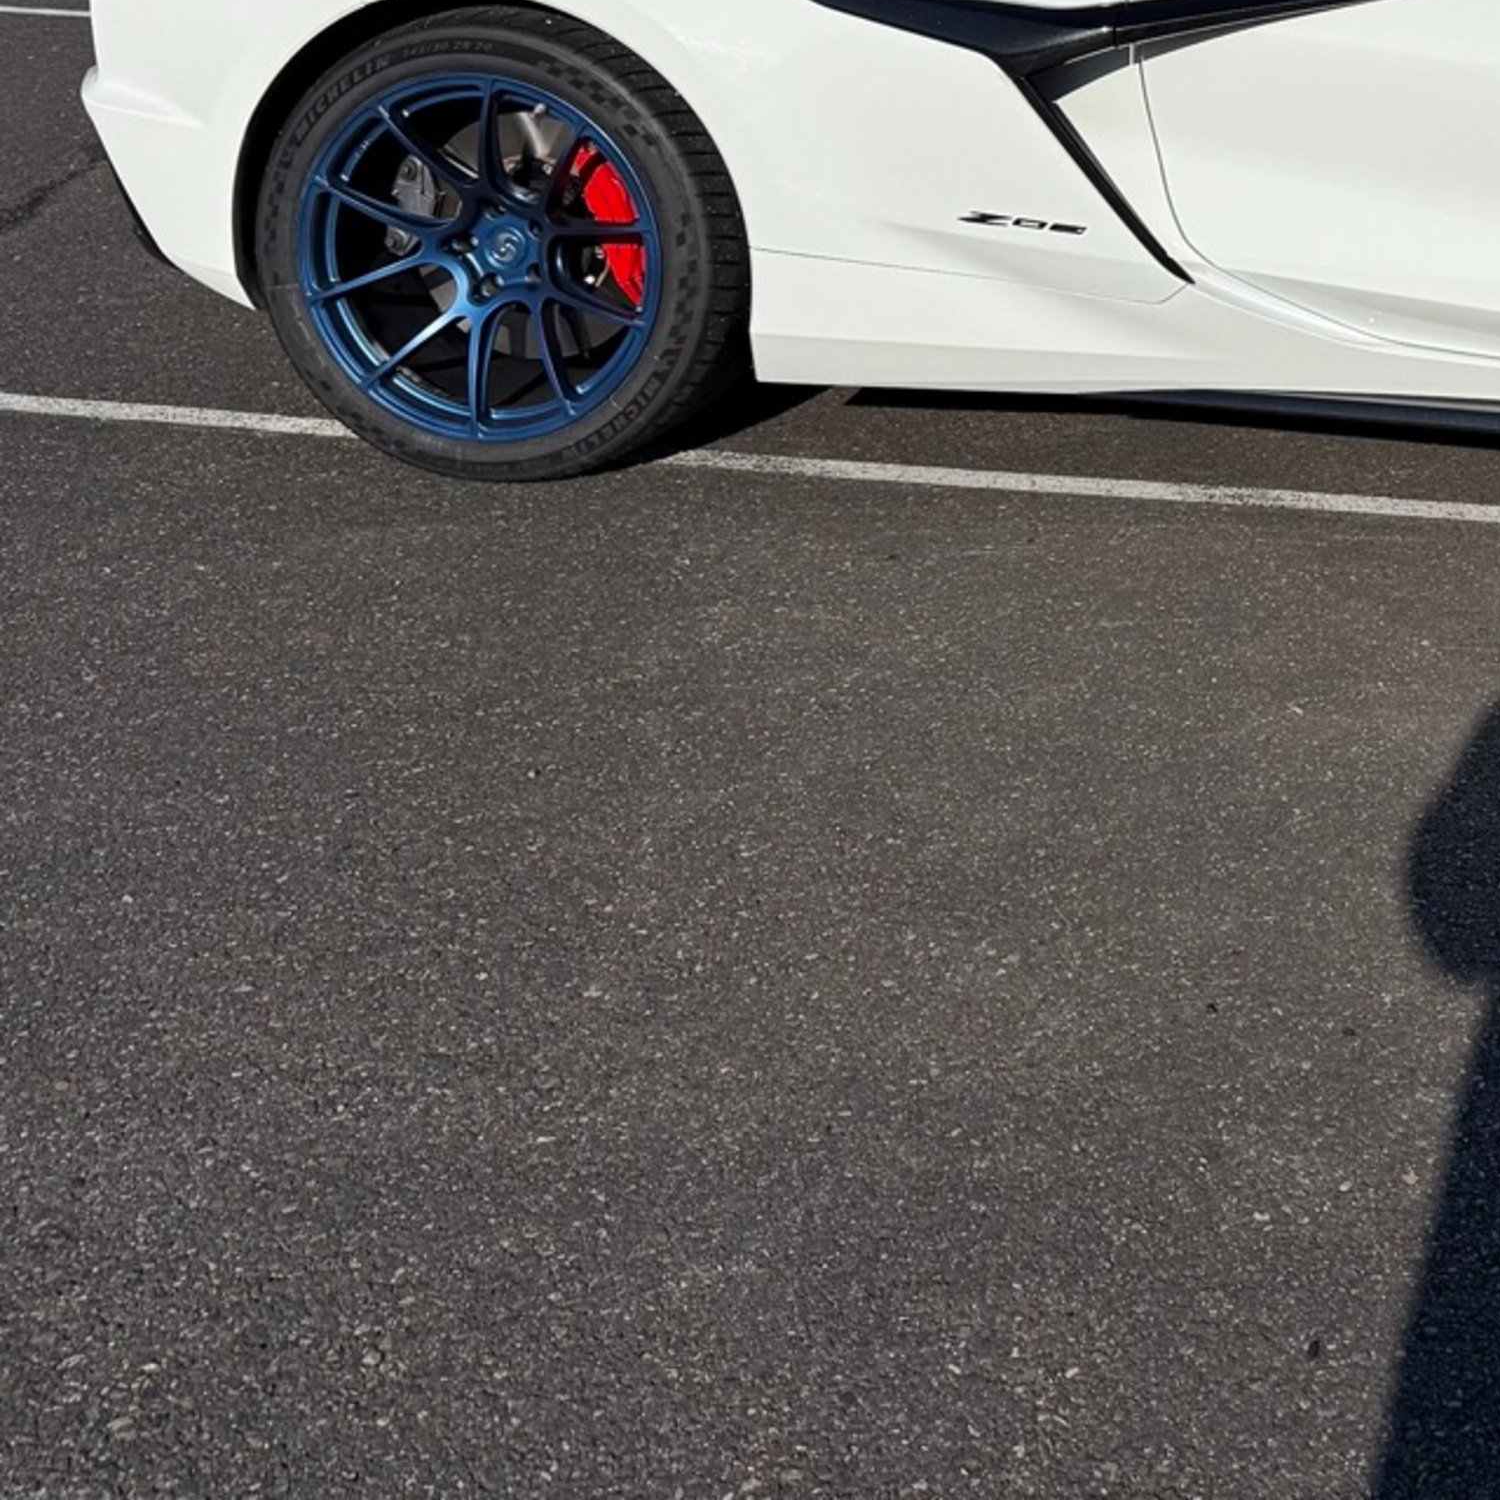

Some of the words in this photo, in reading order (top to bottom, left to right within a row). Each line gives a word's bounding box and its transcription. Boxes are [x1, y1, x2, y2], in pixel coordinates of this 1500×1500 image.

[294, 53, 392, 139] MICHELIN
[956, 209, 1088, 236] Z06
[561, 370, 664, 461] MICHELIN
